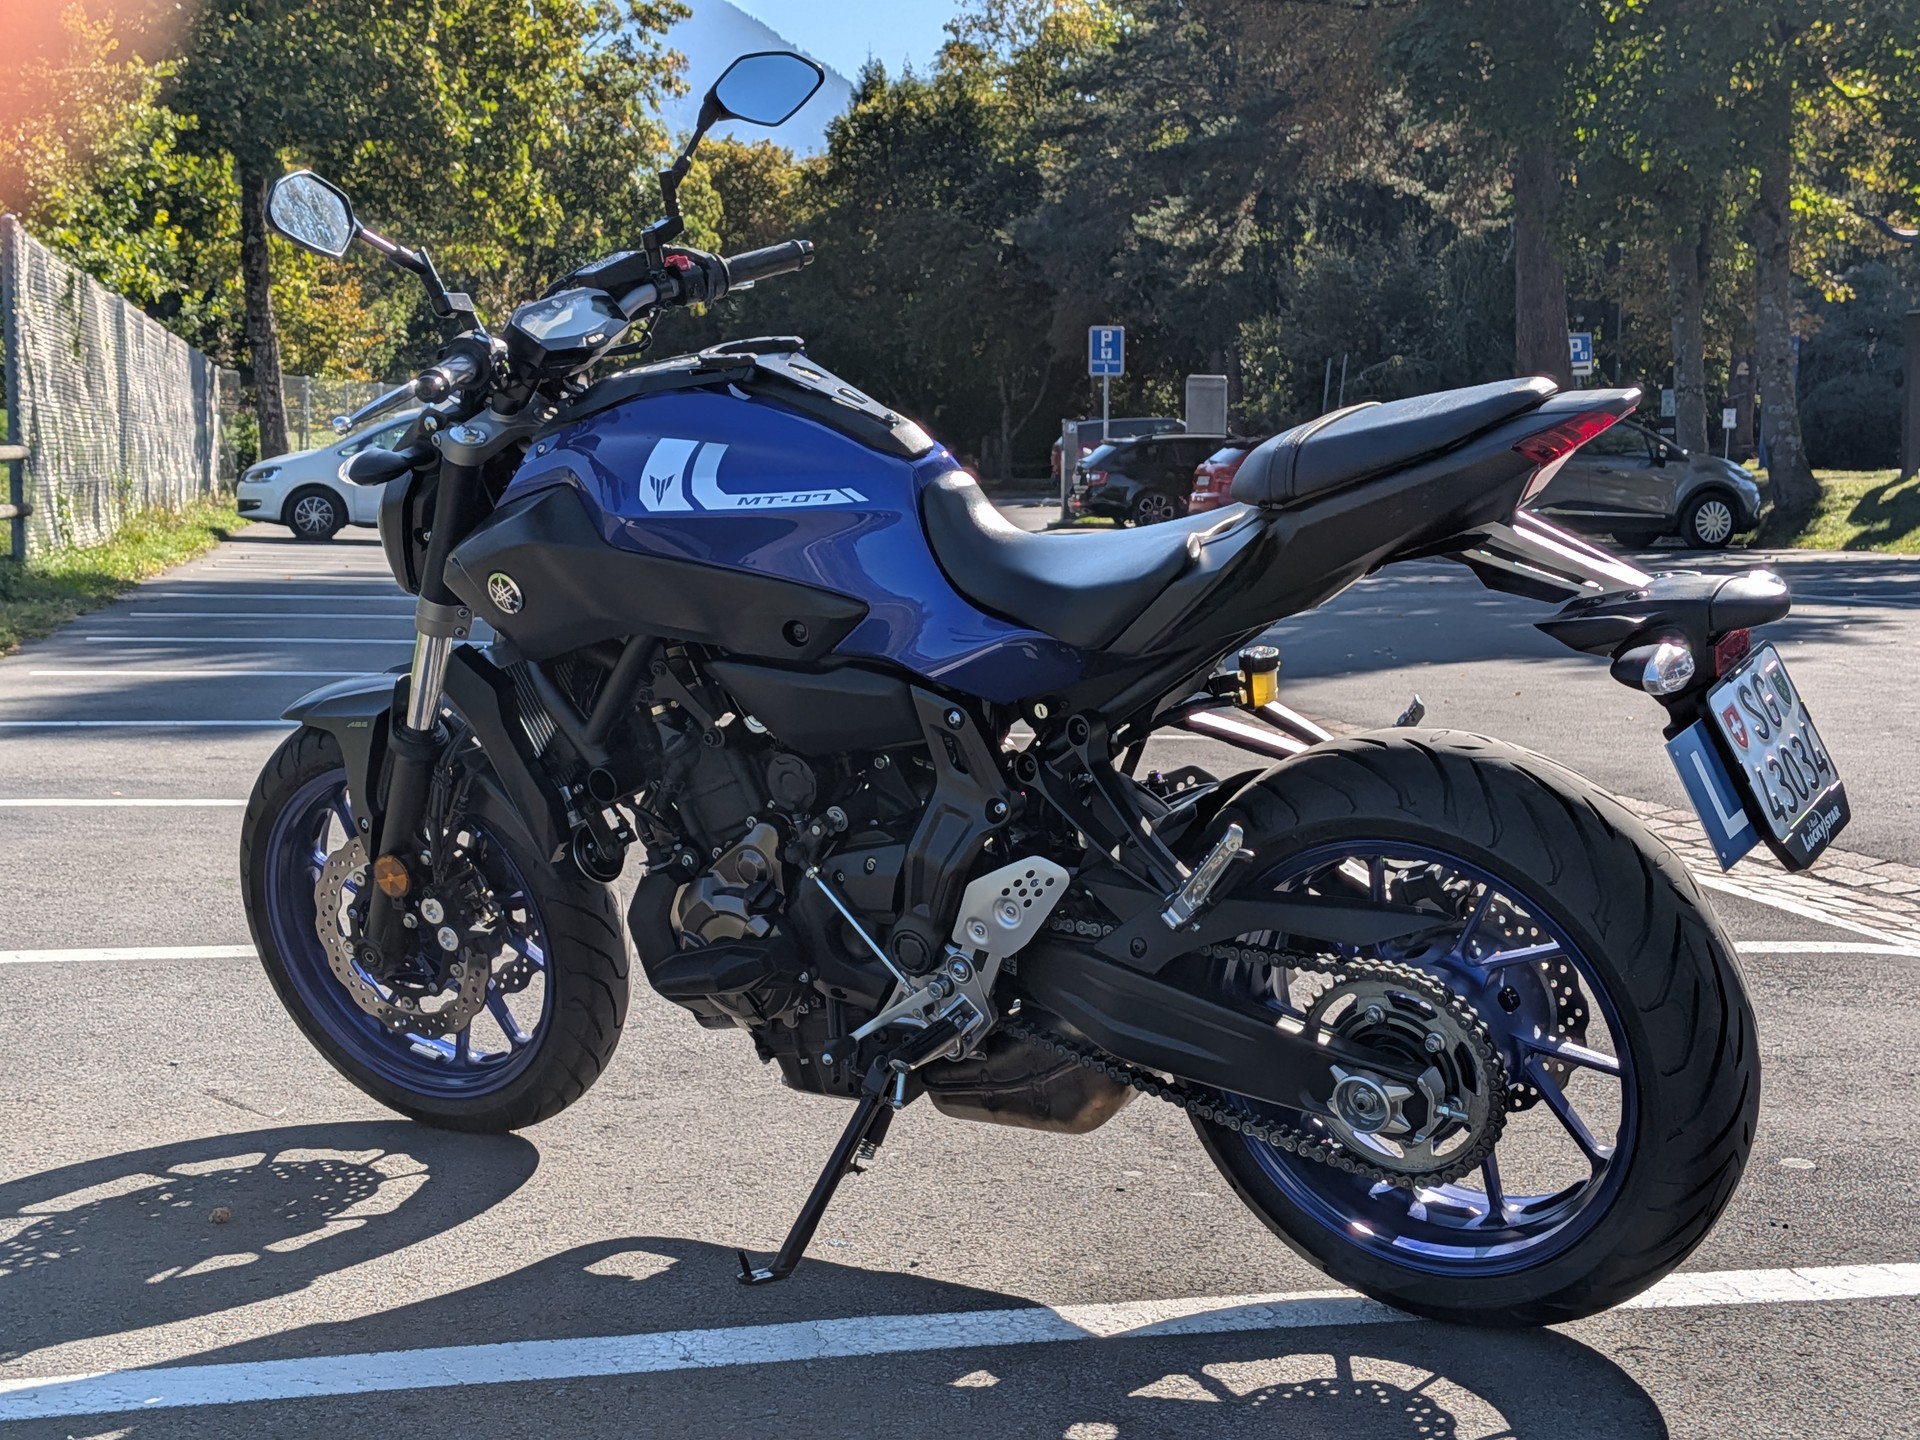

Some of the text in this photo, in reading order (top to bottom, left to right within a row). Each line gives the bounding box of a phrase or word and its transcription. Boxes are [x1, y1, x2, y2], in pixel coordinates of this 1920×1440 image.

[1101, 330, 1112, 347] P
[1570, 338, 1582, 360] P
[737, 493, 832, 506] MT-07
[1737, 672, 1781, 739] SG
[1755, 721, 1831, 822] 43034
[1690, 750, 1749, 840] L
